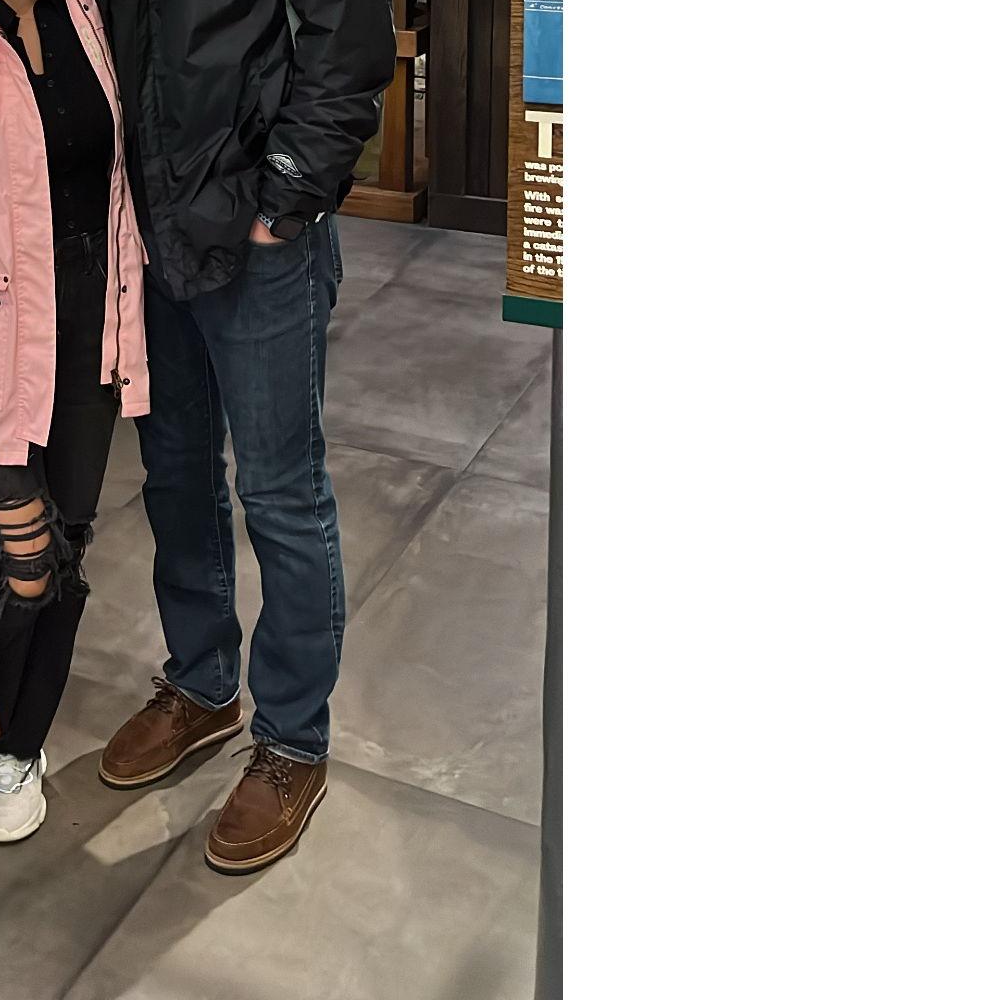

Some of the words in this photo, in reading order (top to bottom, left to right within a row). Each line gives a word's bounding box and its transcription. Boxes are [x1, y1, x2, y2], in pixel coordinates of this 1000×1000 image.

[524, 162, 547, 171] was
[524, 190, 551, 202] With
[524, 202, 543, 214] fire
[524, 216, 552, 227] were
[523, 241, 531, 249] a
[523, 251, 533, 261] in
[535, 253, 554, 264] the
[522, 264, 535, 273] of
[536, 265, 556, 276] the
